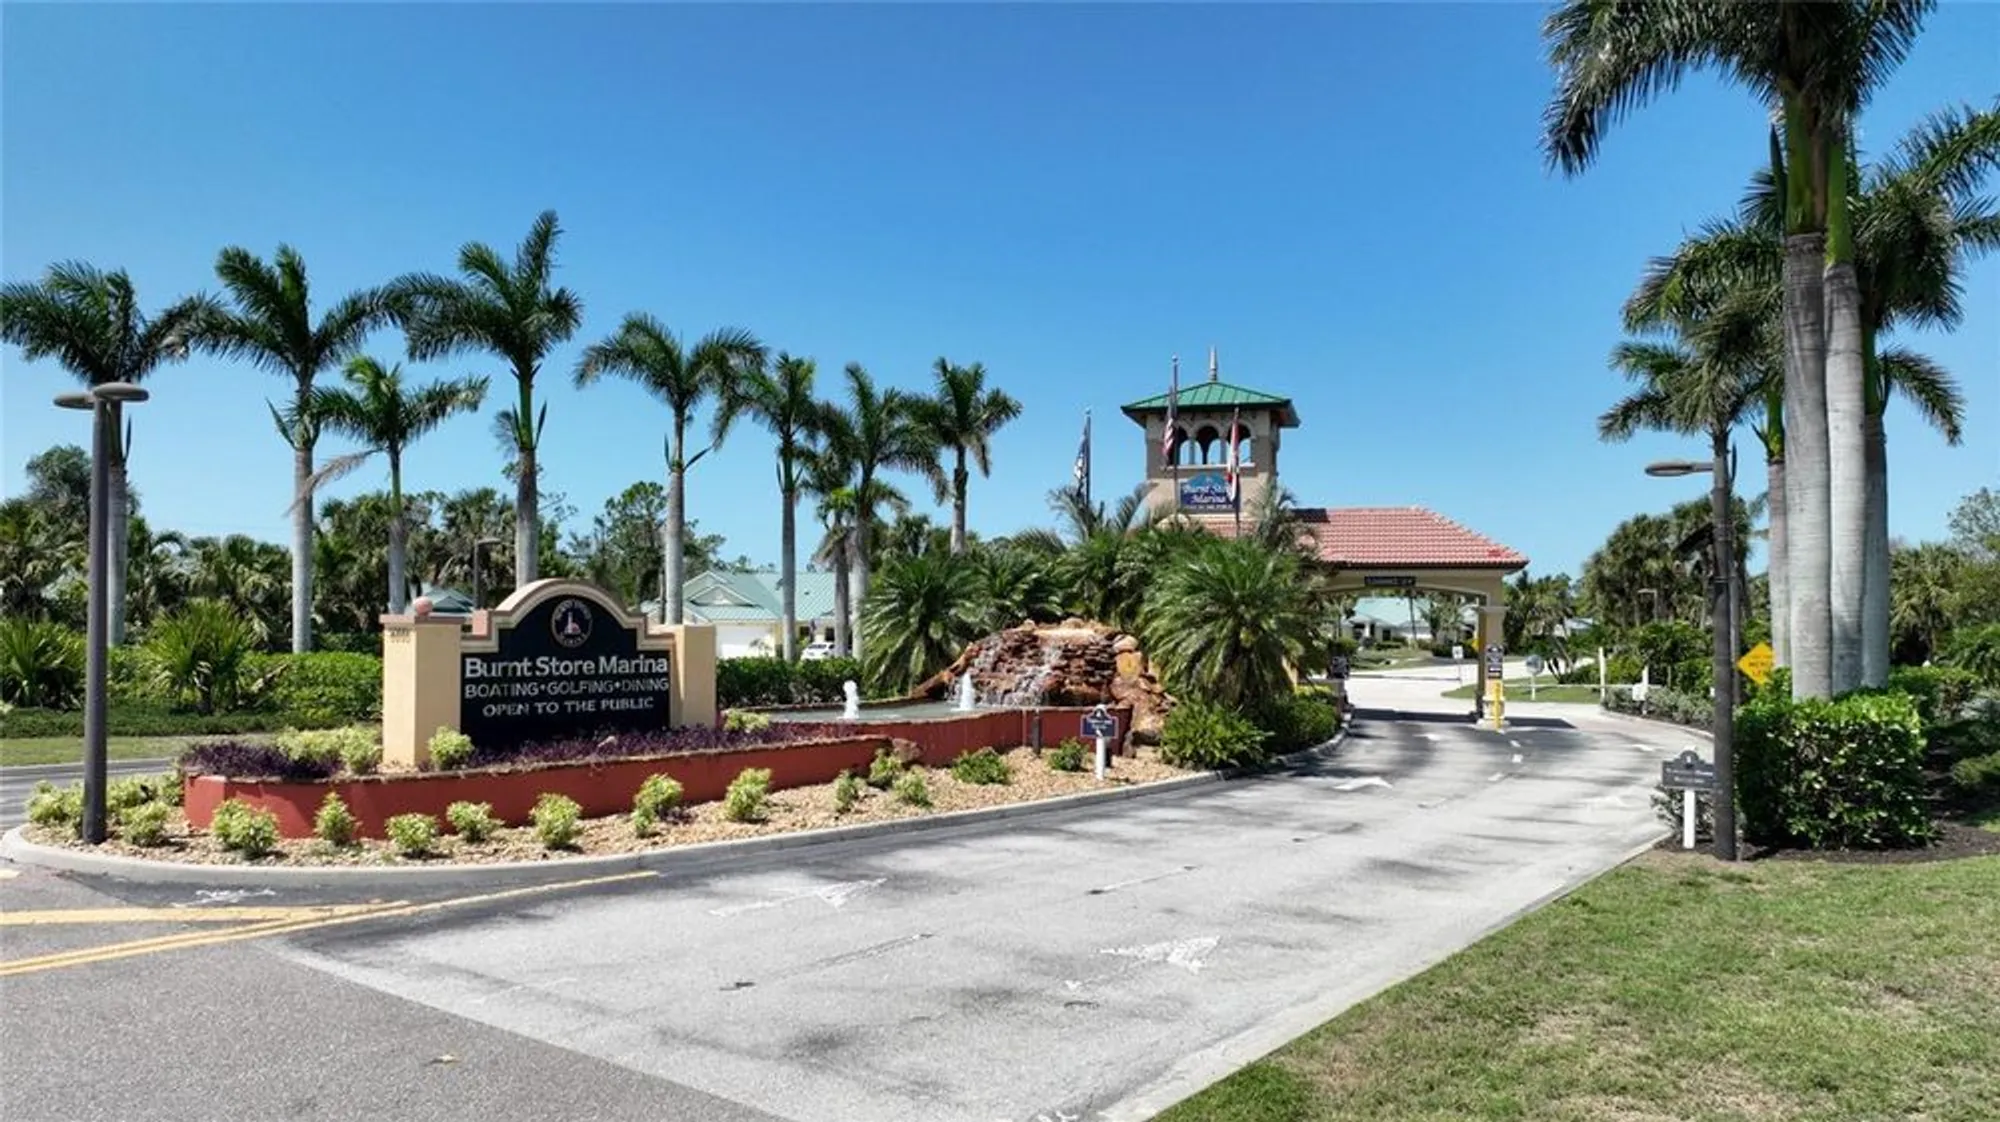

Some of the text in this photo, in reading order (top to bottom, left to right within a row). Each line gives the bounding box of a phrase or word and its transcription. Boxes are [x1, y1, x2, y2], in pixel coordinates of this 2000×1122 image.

[464, 654, 668, 678] Burnt Store Marina
[482, 696, 655, 717] OPEN TO THE PUBLIC
